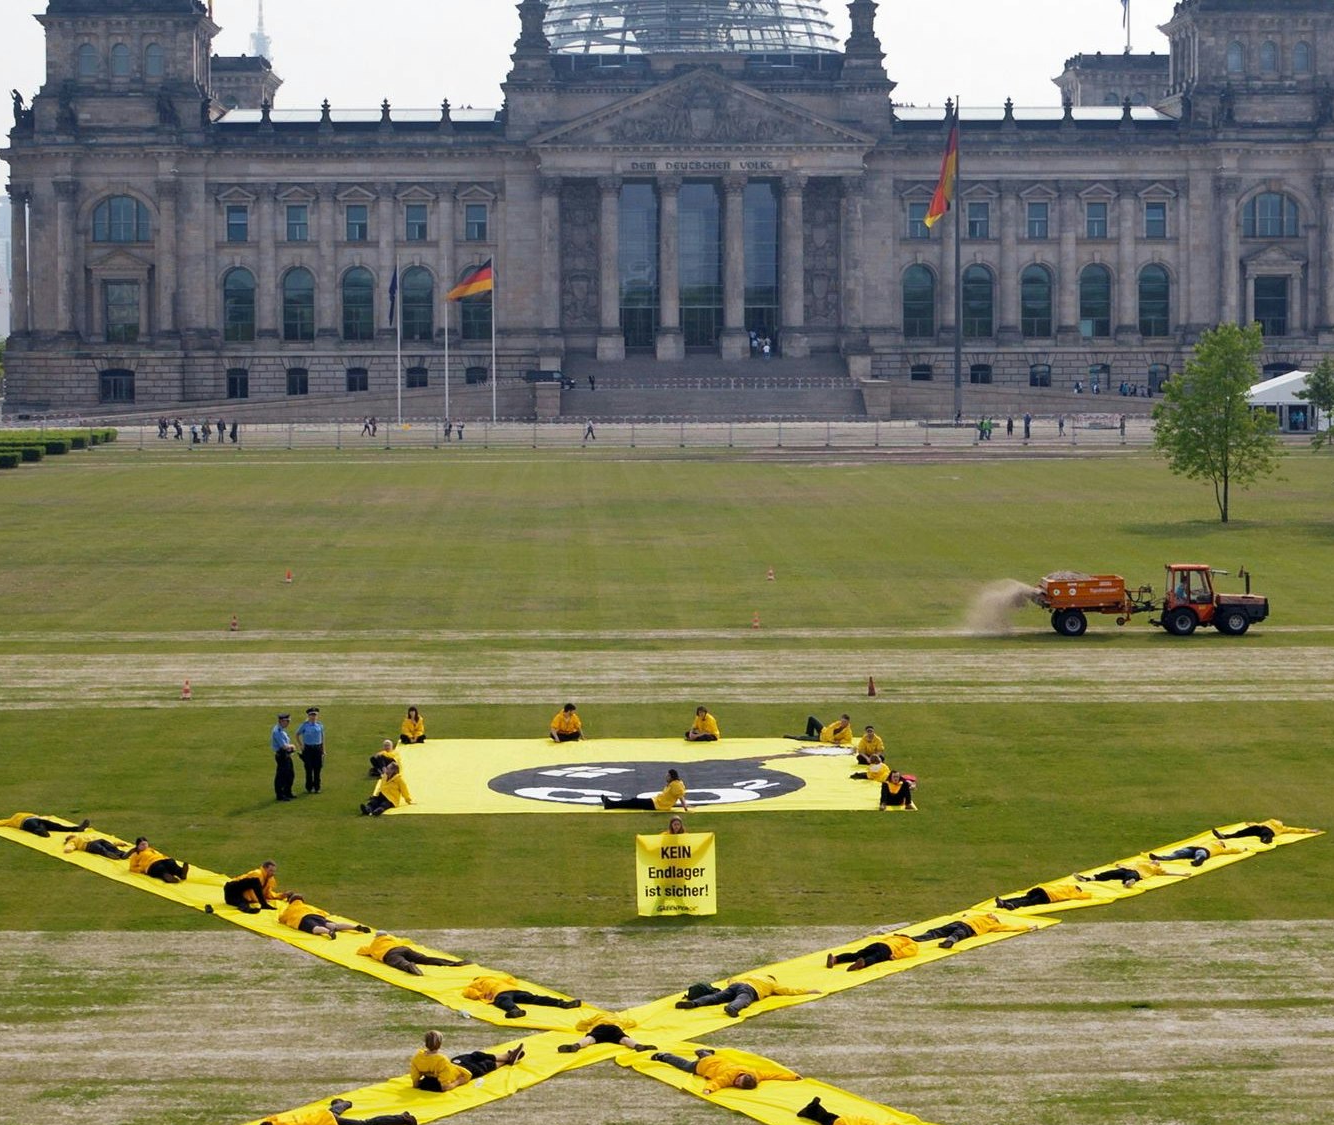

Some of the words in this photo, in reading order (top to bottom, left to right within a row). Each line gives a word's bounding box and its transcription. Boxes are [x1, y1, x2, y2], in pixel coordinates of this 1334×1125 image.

[630, 161, 657, 170] DEM
[666, 161, 731, 170] DEUTSCHEN
[739, 161, 773, 170] VOLKE
[661, 846, 691, 859] KEIN
[648, 866, 705, 880] Endlager
[645, 885, 661, 897] ist
[664, 885, 709, 897] sicher!
